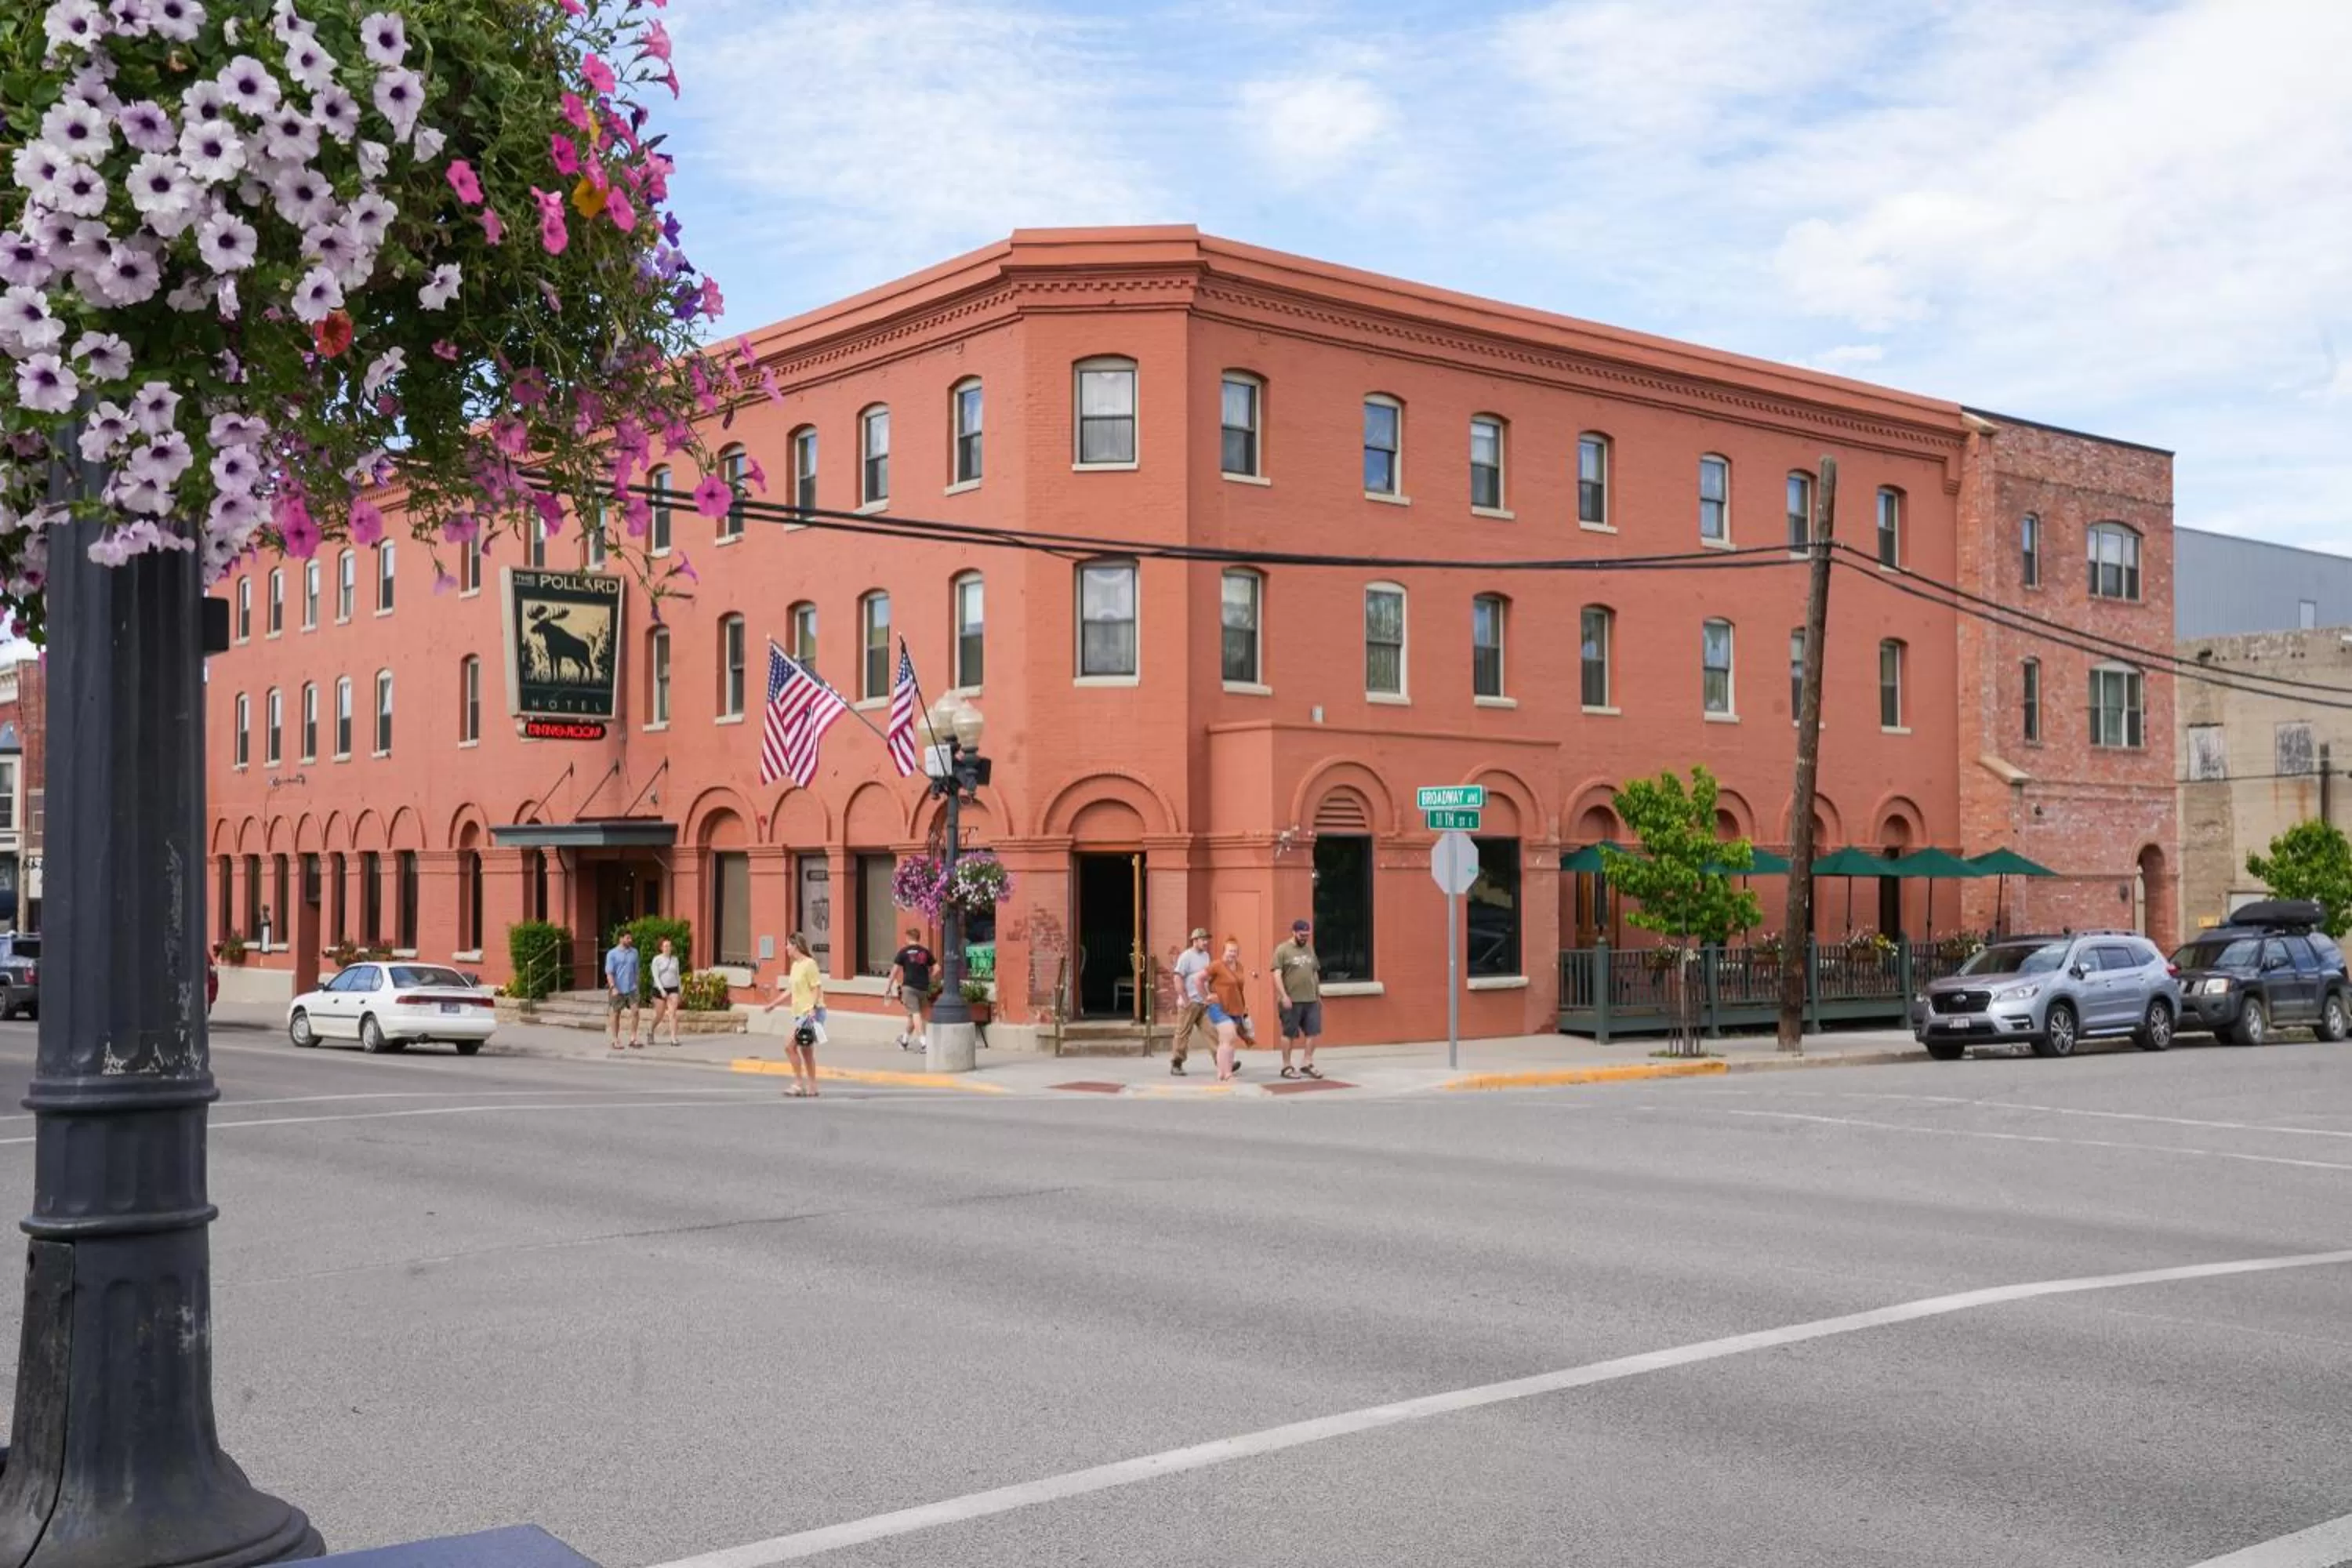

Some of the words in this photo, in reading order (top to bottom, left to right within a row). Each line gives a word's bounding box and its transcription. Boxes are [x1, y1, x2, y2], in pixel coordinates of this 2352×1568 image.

[539, 574, 619, 594] POLLARD
[531, 699, 601, 713] HOTEL
[1421, 789, 1464, 805] BROADWAY
